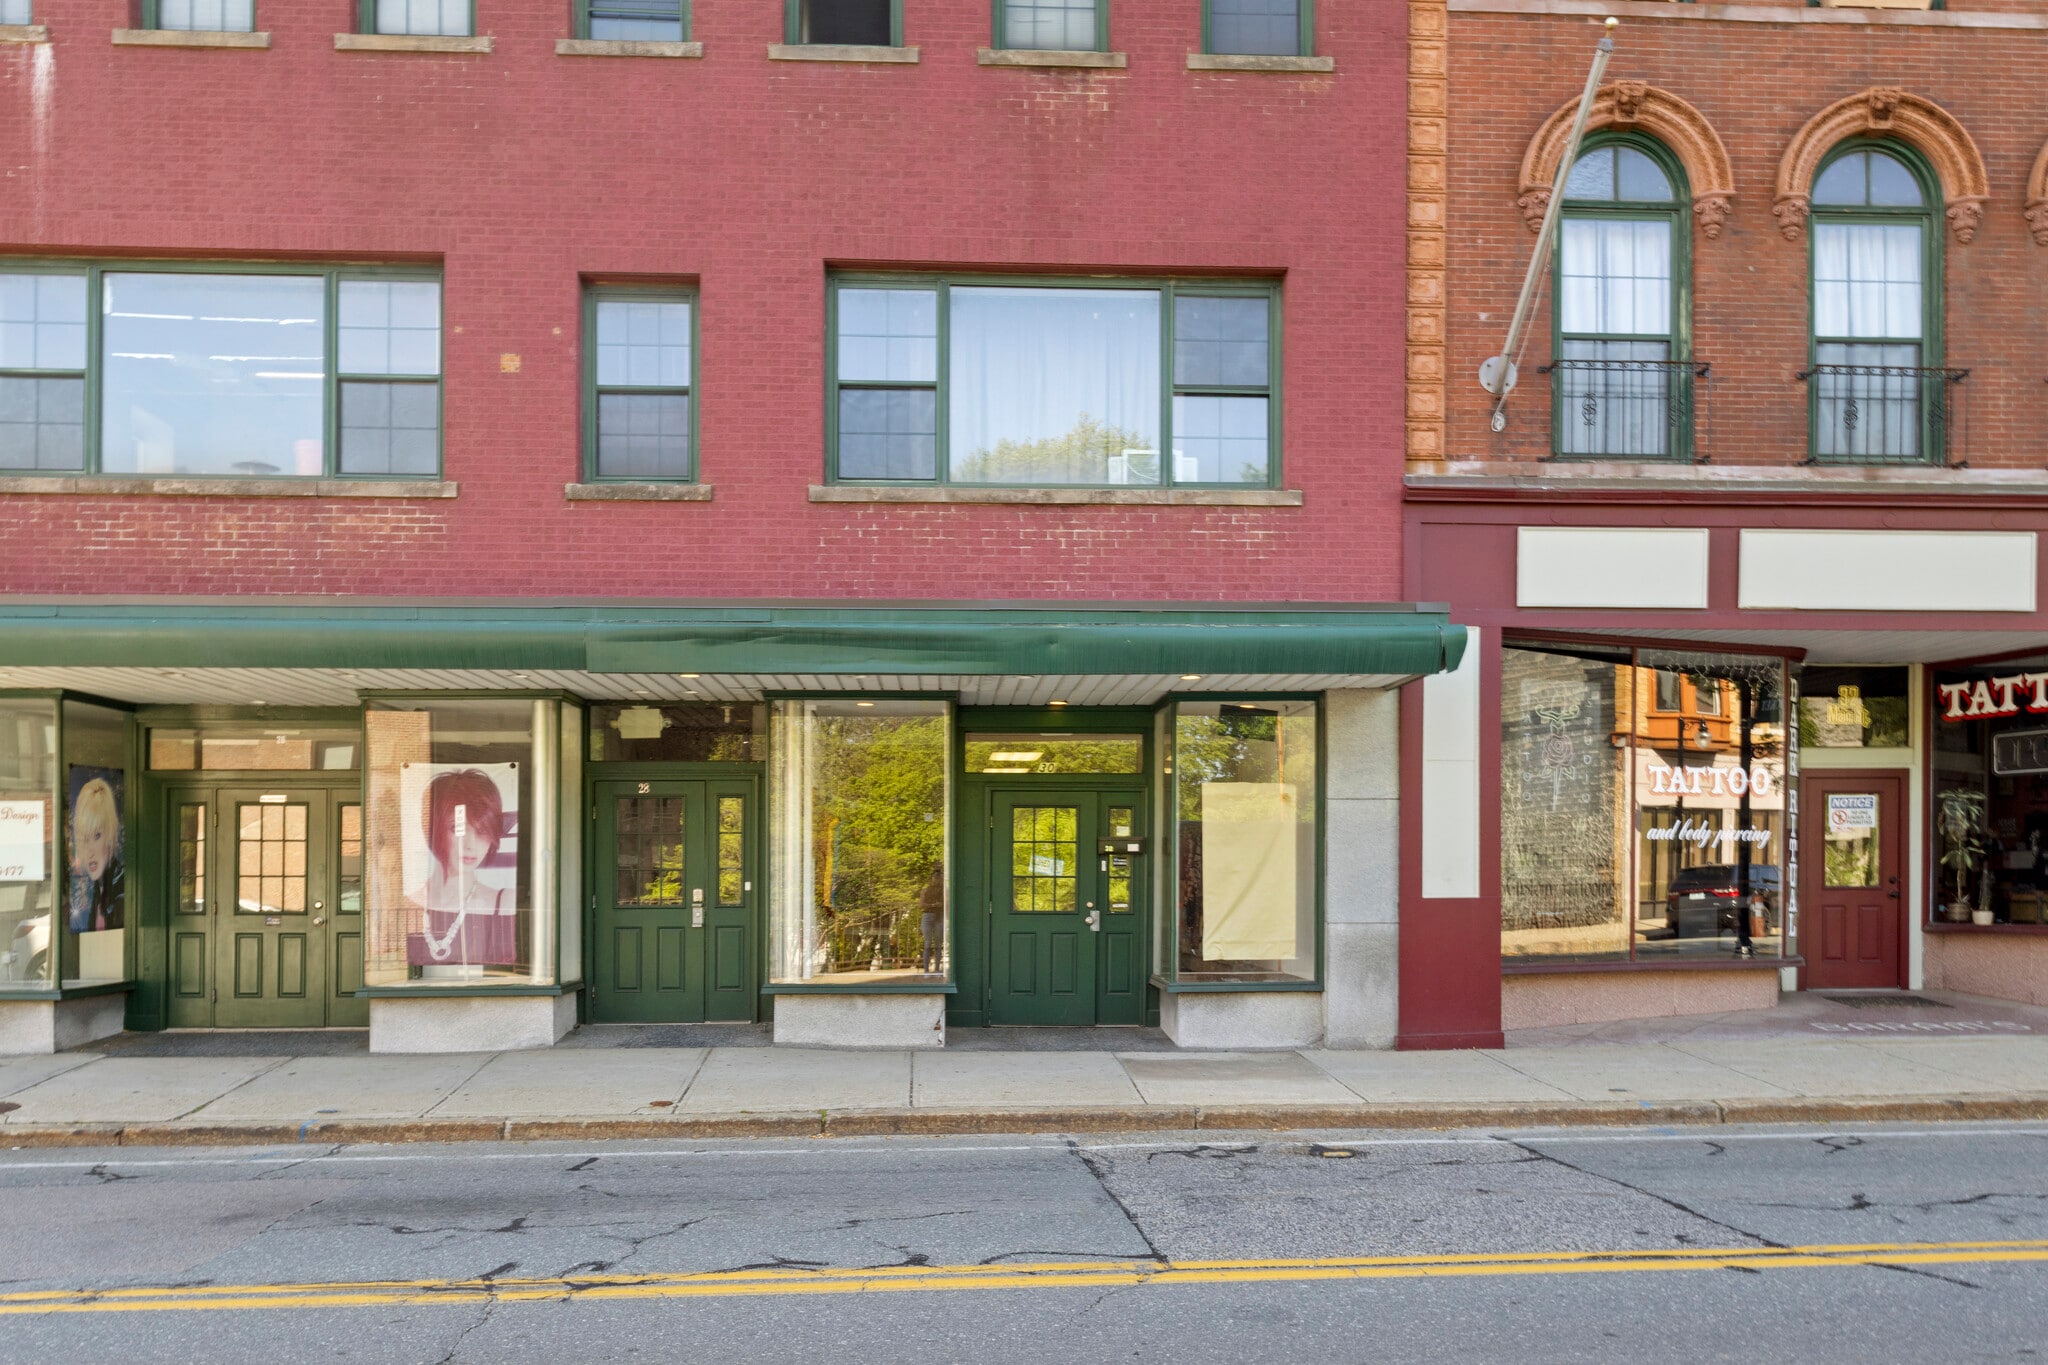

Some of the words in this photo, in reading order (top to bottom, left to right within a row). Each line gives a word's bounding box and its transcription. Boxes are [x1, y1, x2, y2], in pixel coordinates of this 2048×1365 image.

[1789, 678, 1800, 777] DARK
[1039, 763, 1054, 772] 30
[1647, 764, 1771, 797] TATTOO
[1831, 798, 1872, 808] NOTICE
[1646, 819, 1681, 841] and
[1678, 818, 1712, 849] body
[1711, 824, 1772, 849] piercing
[1788, 789, 1799, 937] RITUAL
